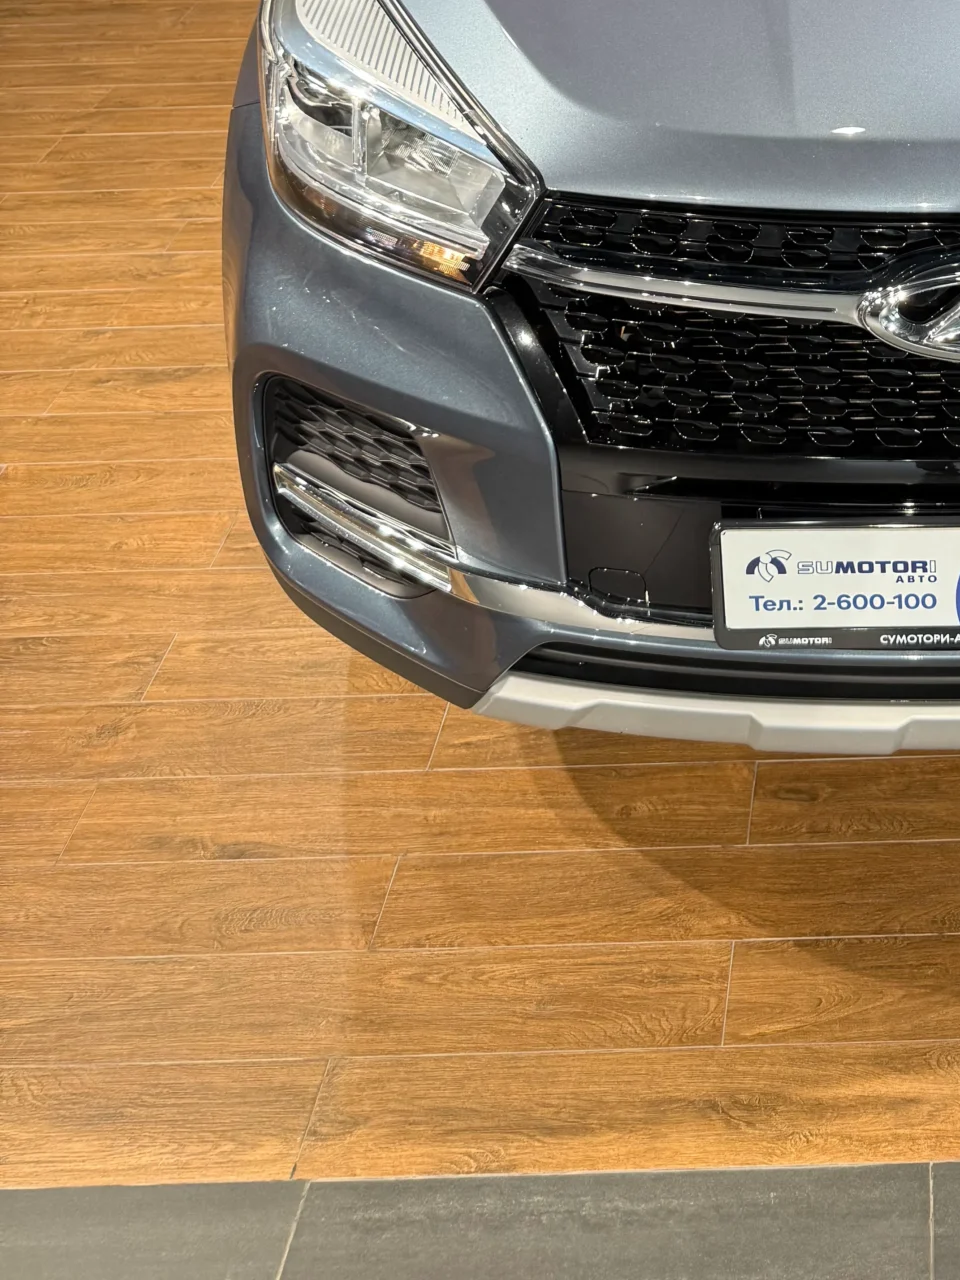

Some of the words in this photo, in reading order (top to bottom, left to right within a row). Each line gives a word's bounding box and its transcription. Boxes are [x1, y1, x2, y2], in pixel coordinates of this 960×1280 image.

[797, 560, 937, 574] SUMOTORI
[896, 575, 938, 583] АВТО
[749, 595, 804, 612] Тел.:
[813, 593, 937, 611] 2-600-100
